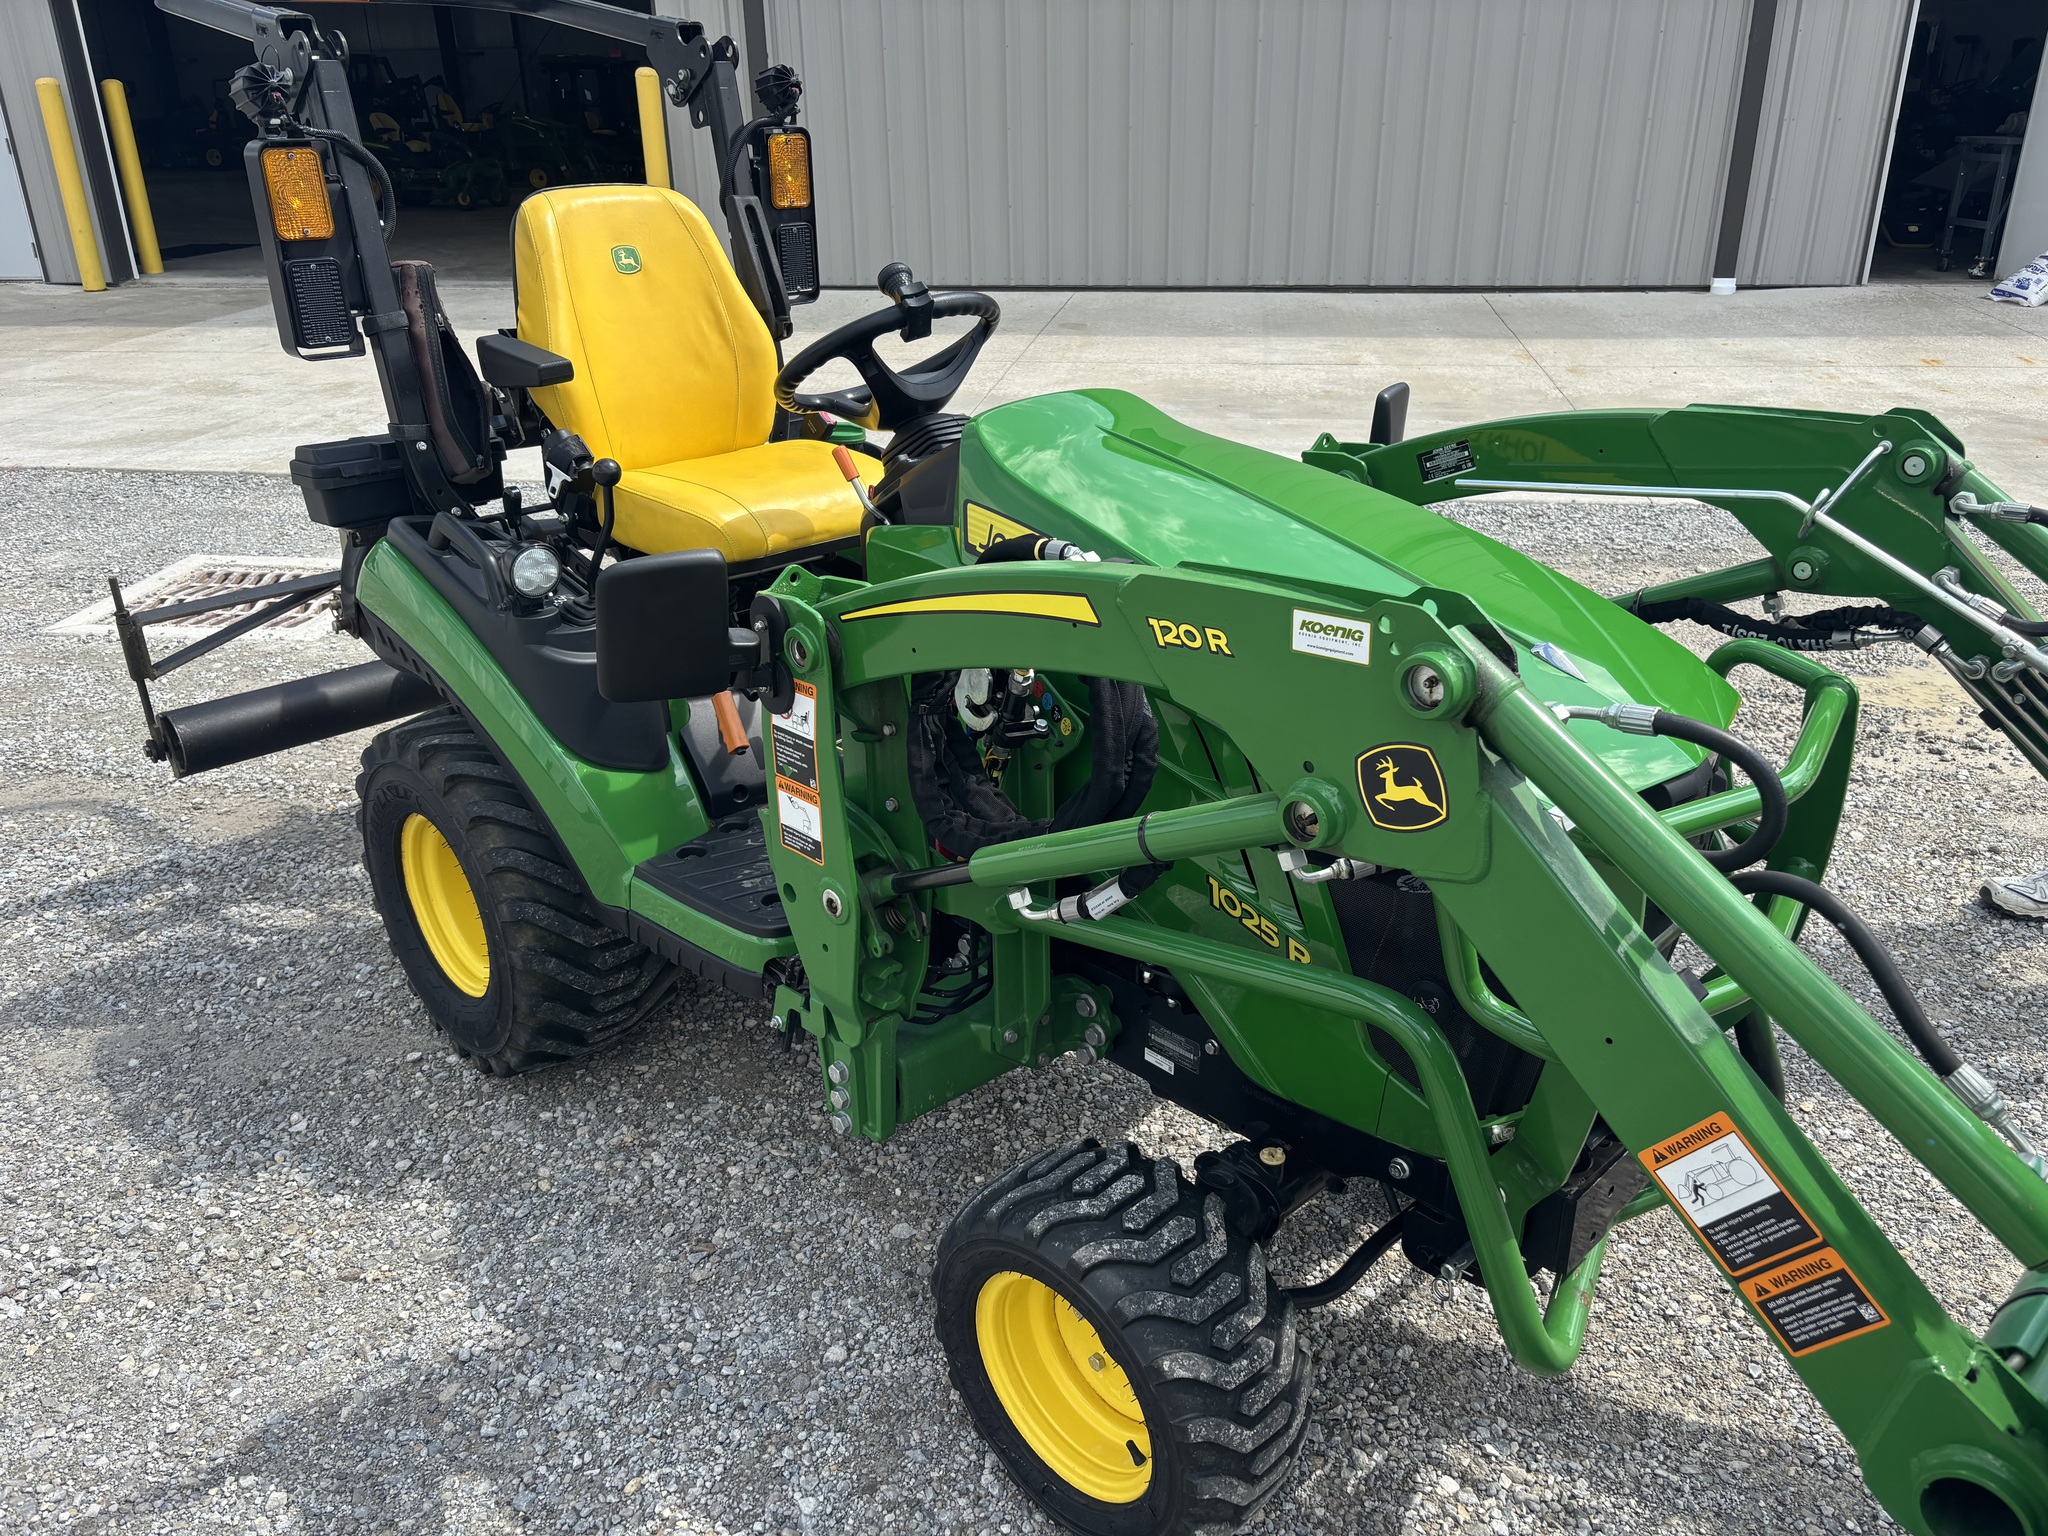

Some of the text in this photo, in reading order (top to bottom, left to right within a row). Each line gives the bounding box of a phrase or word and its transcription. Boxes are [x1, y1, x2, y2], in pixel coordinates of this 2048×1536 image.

[1146, 617, 1234, 657] 120 R
[1299, 631, 1317, 639] KOENIG
[795, 682, 813, 696] NING
[784, 782, 818, 804] WARNING
[1206, 874, 1312, 964] 1025 R
[1663, 1122, 1723, 1156] WARNING
[1768, 1257, 1833, 1289] WARNING
